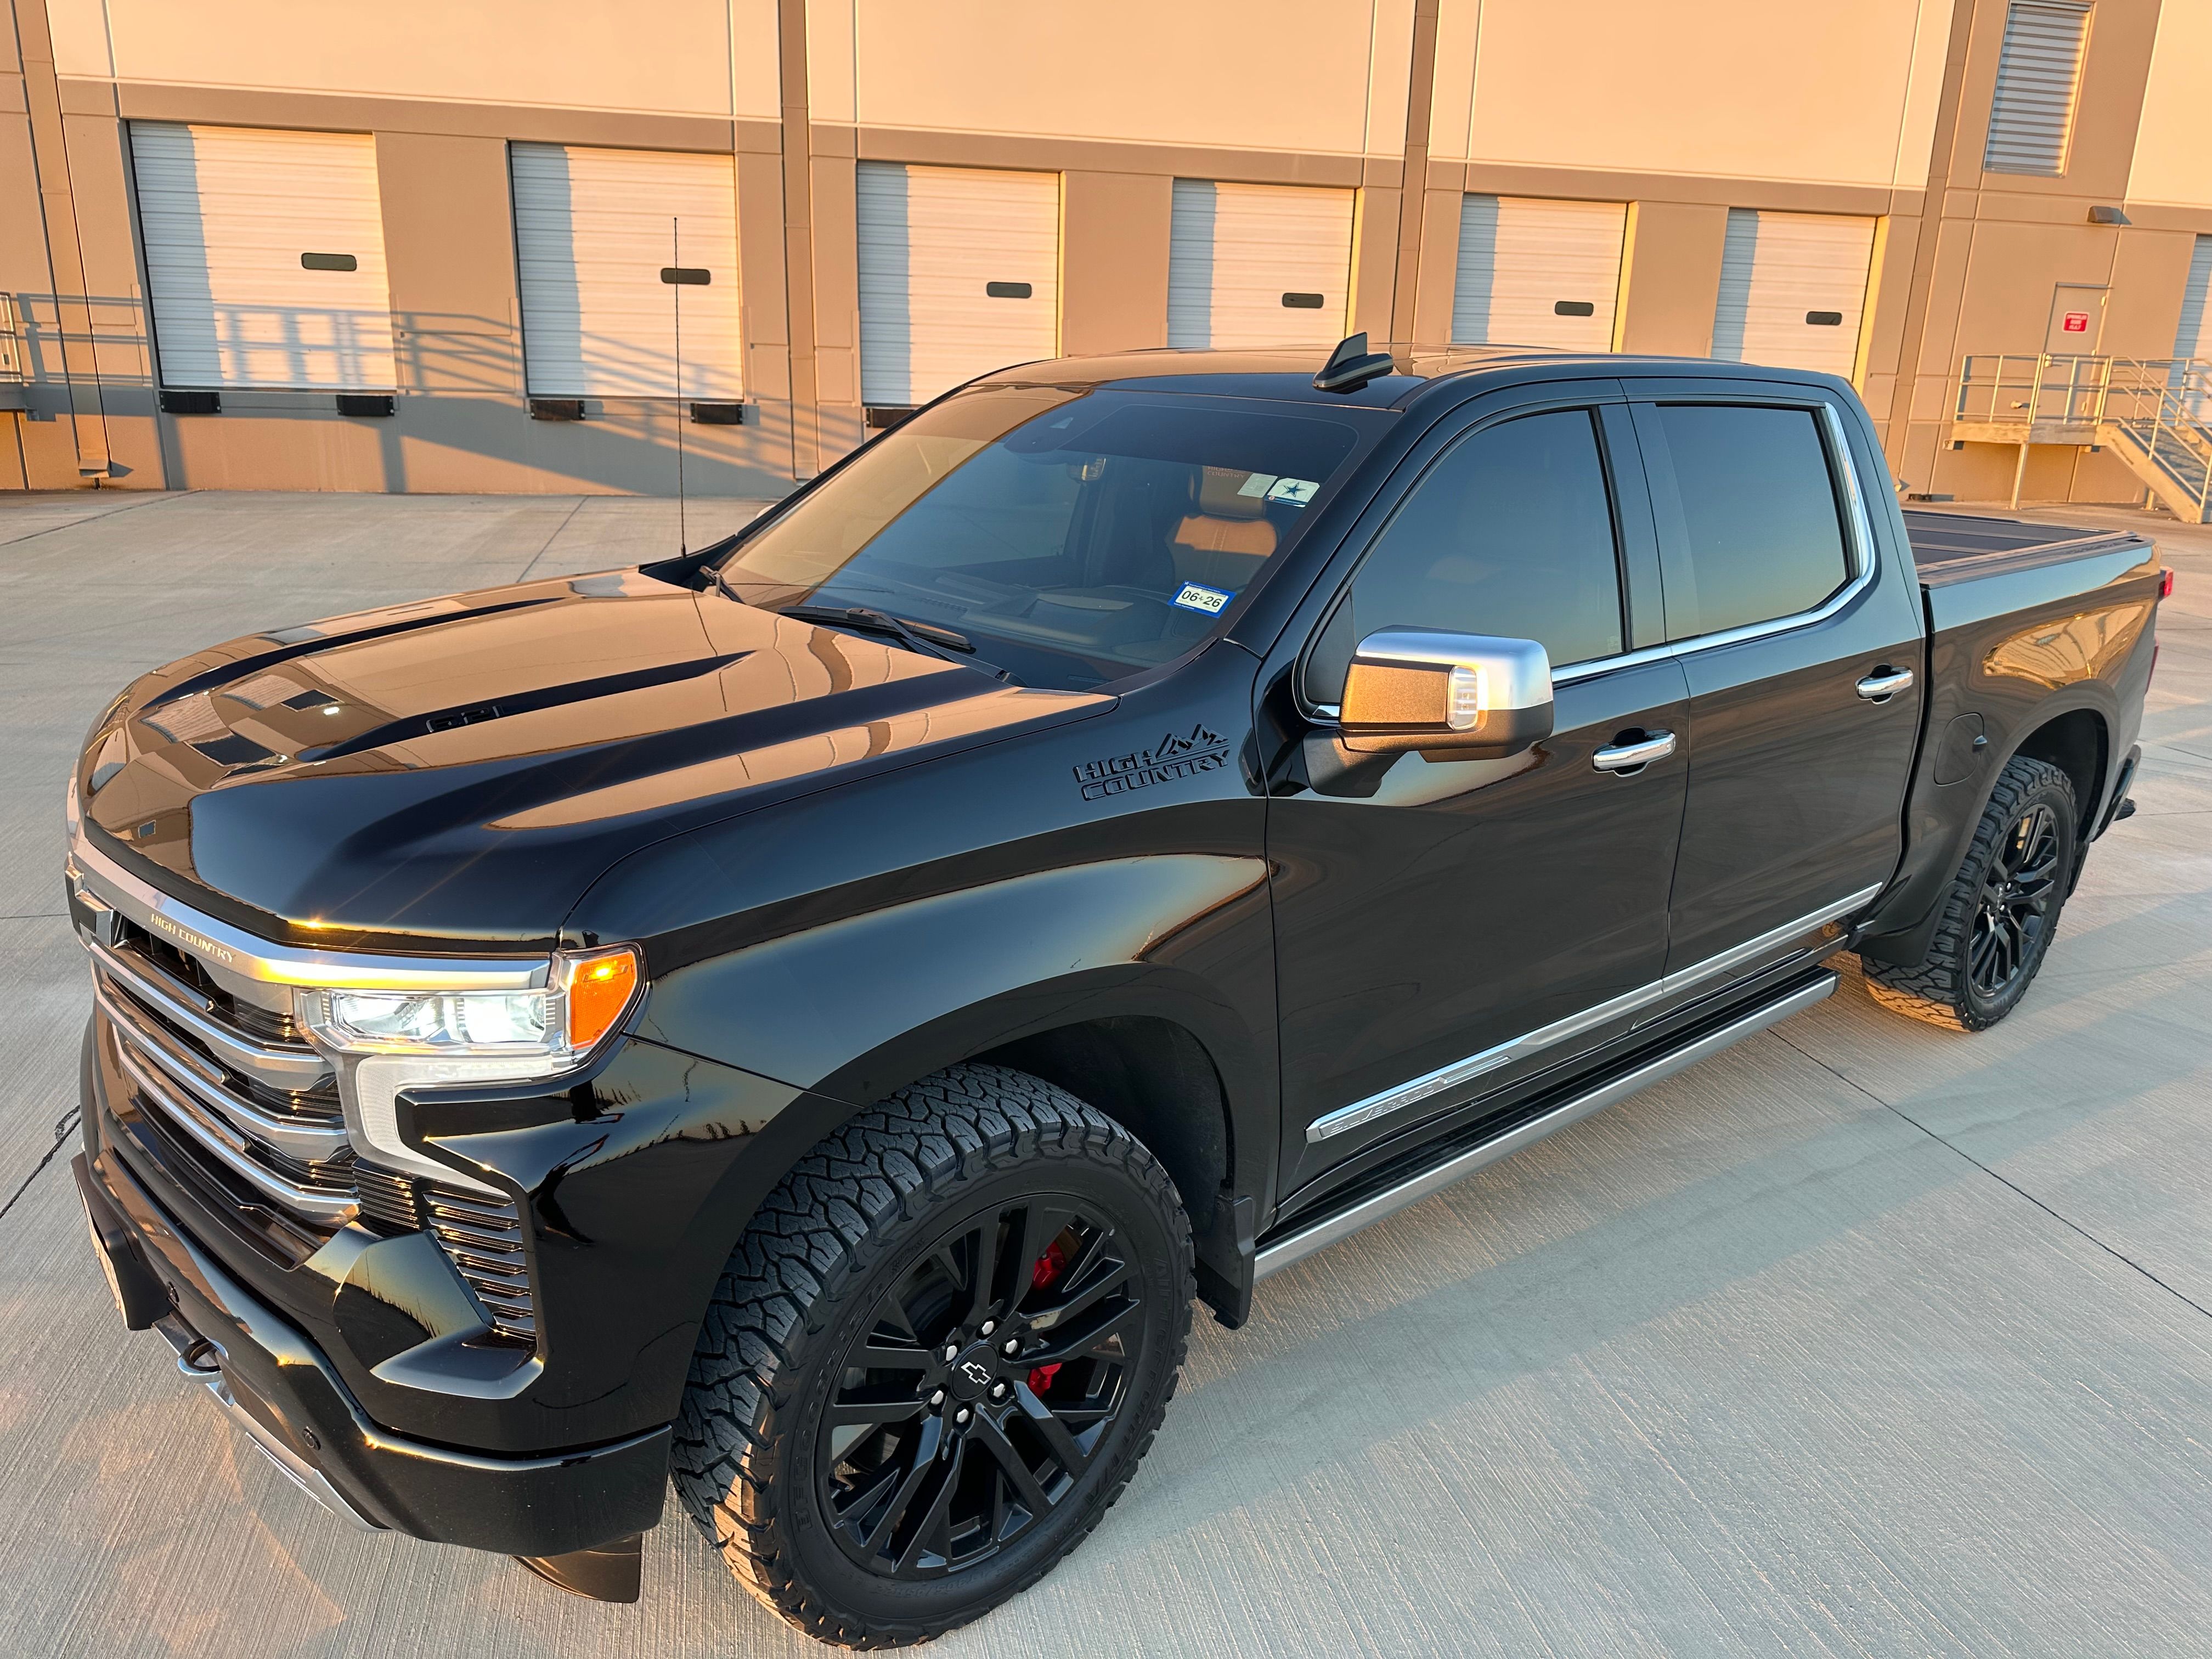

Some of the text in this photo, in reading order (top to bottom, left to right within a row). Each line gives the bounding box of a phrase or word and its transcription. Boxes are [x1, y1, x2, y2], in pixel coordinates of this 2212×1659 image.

[1181, 590, 1200, 601] 06
[1202, 596, 1222, 607] 26
[426, 704, 504, 733] 6.2L
[1073, 749, 1157, 782] HIGH
[1081, 749, 1230, 801] COUNTRY
[151, 913, 236, 963] HIGH COUNTRY
[1330, 1085, 1435, 1134] SILVERADO
[794, 1282, 884, 1532] BFGoodrich
